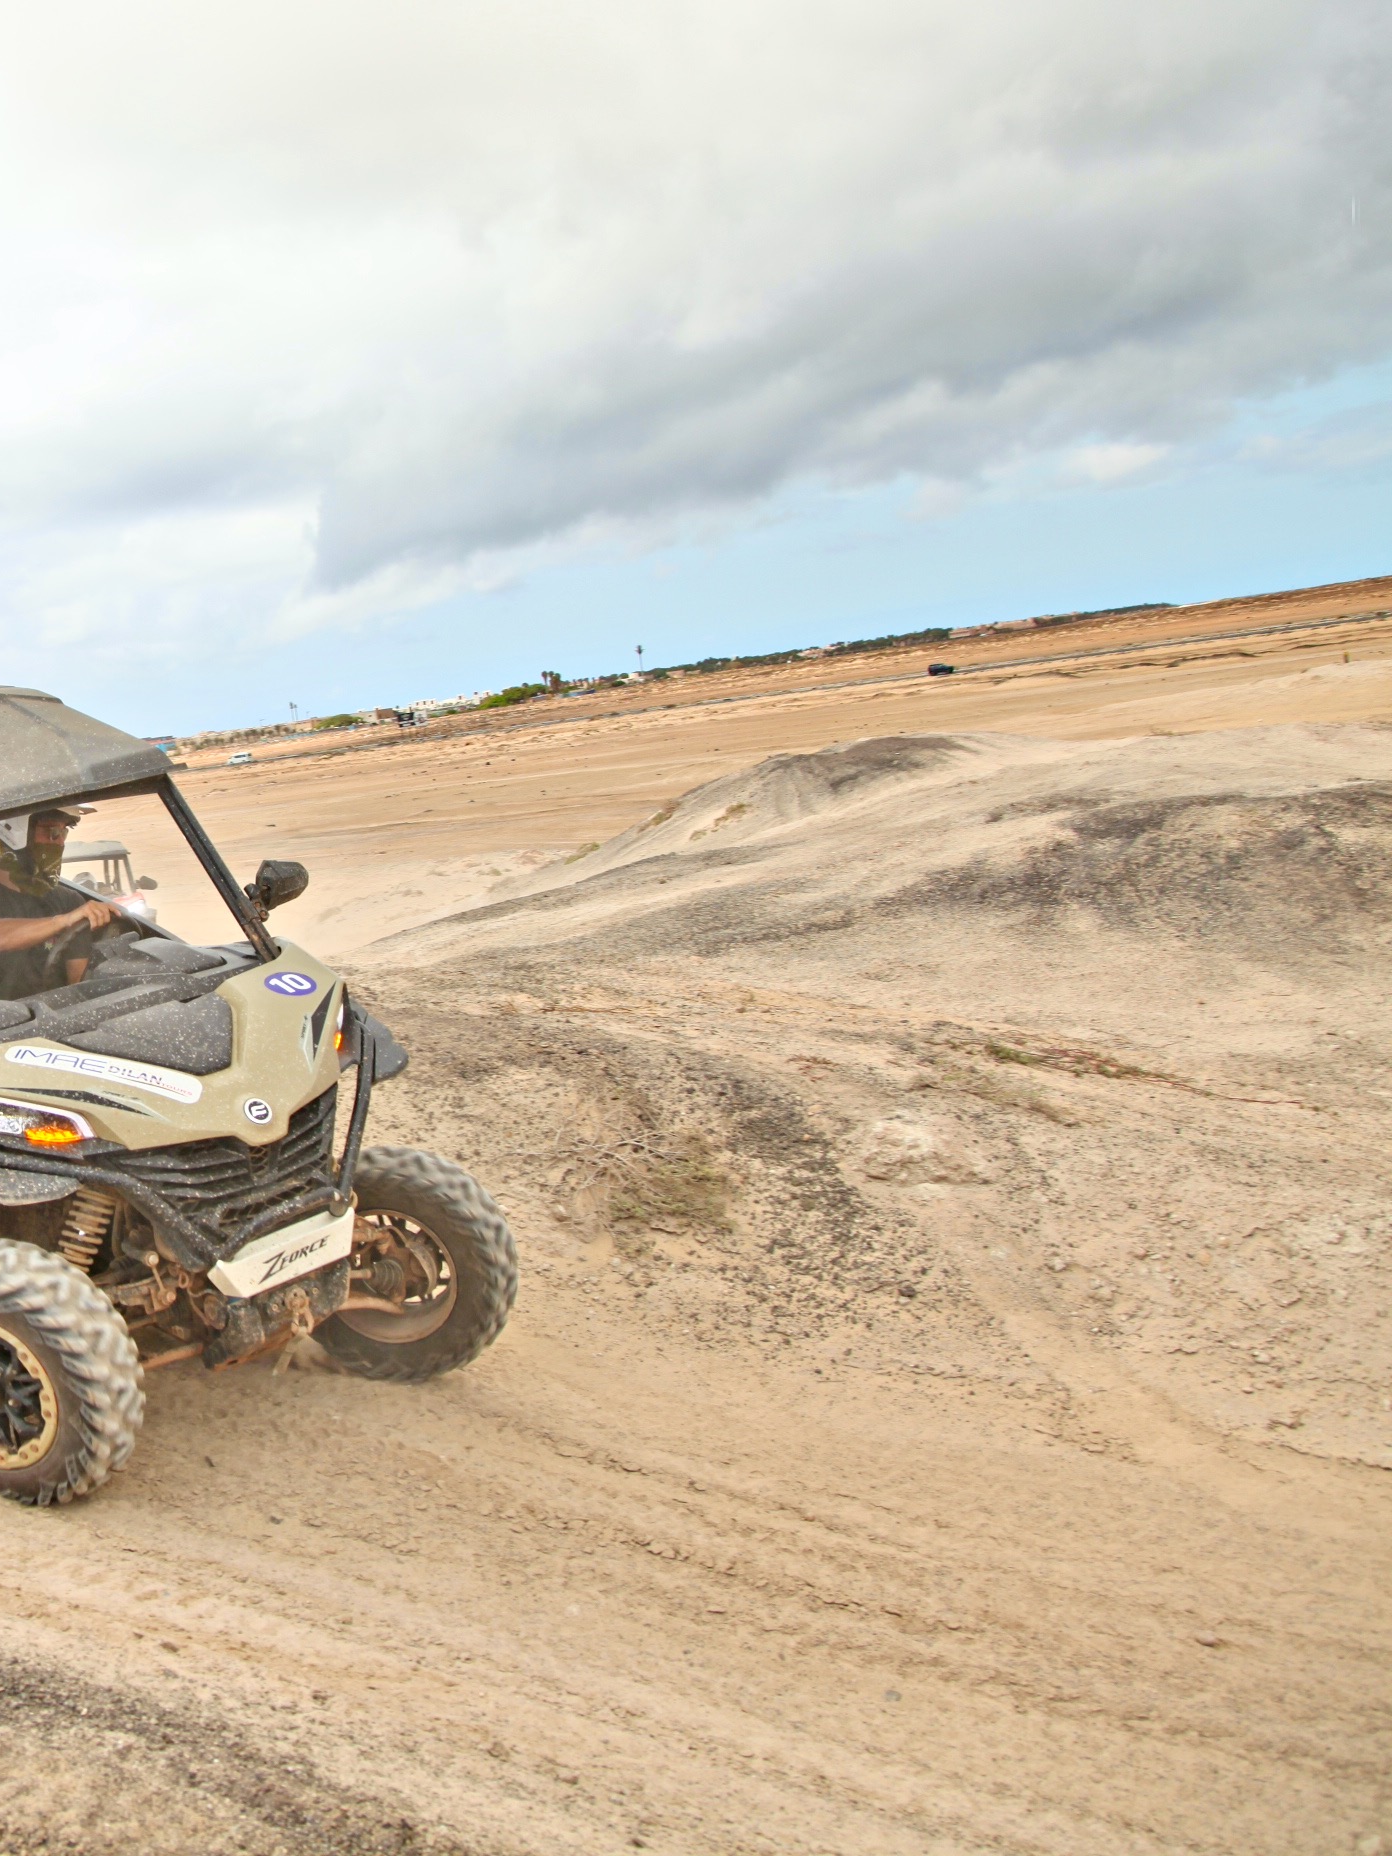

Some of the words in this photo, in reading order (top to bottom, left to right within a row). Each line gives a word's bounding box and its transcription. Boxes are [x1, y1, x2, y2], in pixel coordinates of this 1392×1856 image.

[269, 974, 312, 993] 10
[15, 1049, 107, 1073] IMAE
[108, 1066, 162, 1084] DILAN
[161, 1083, 193, 1096] TOURS
[258, 1235, 330, 1285] ZFORCE
